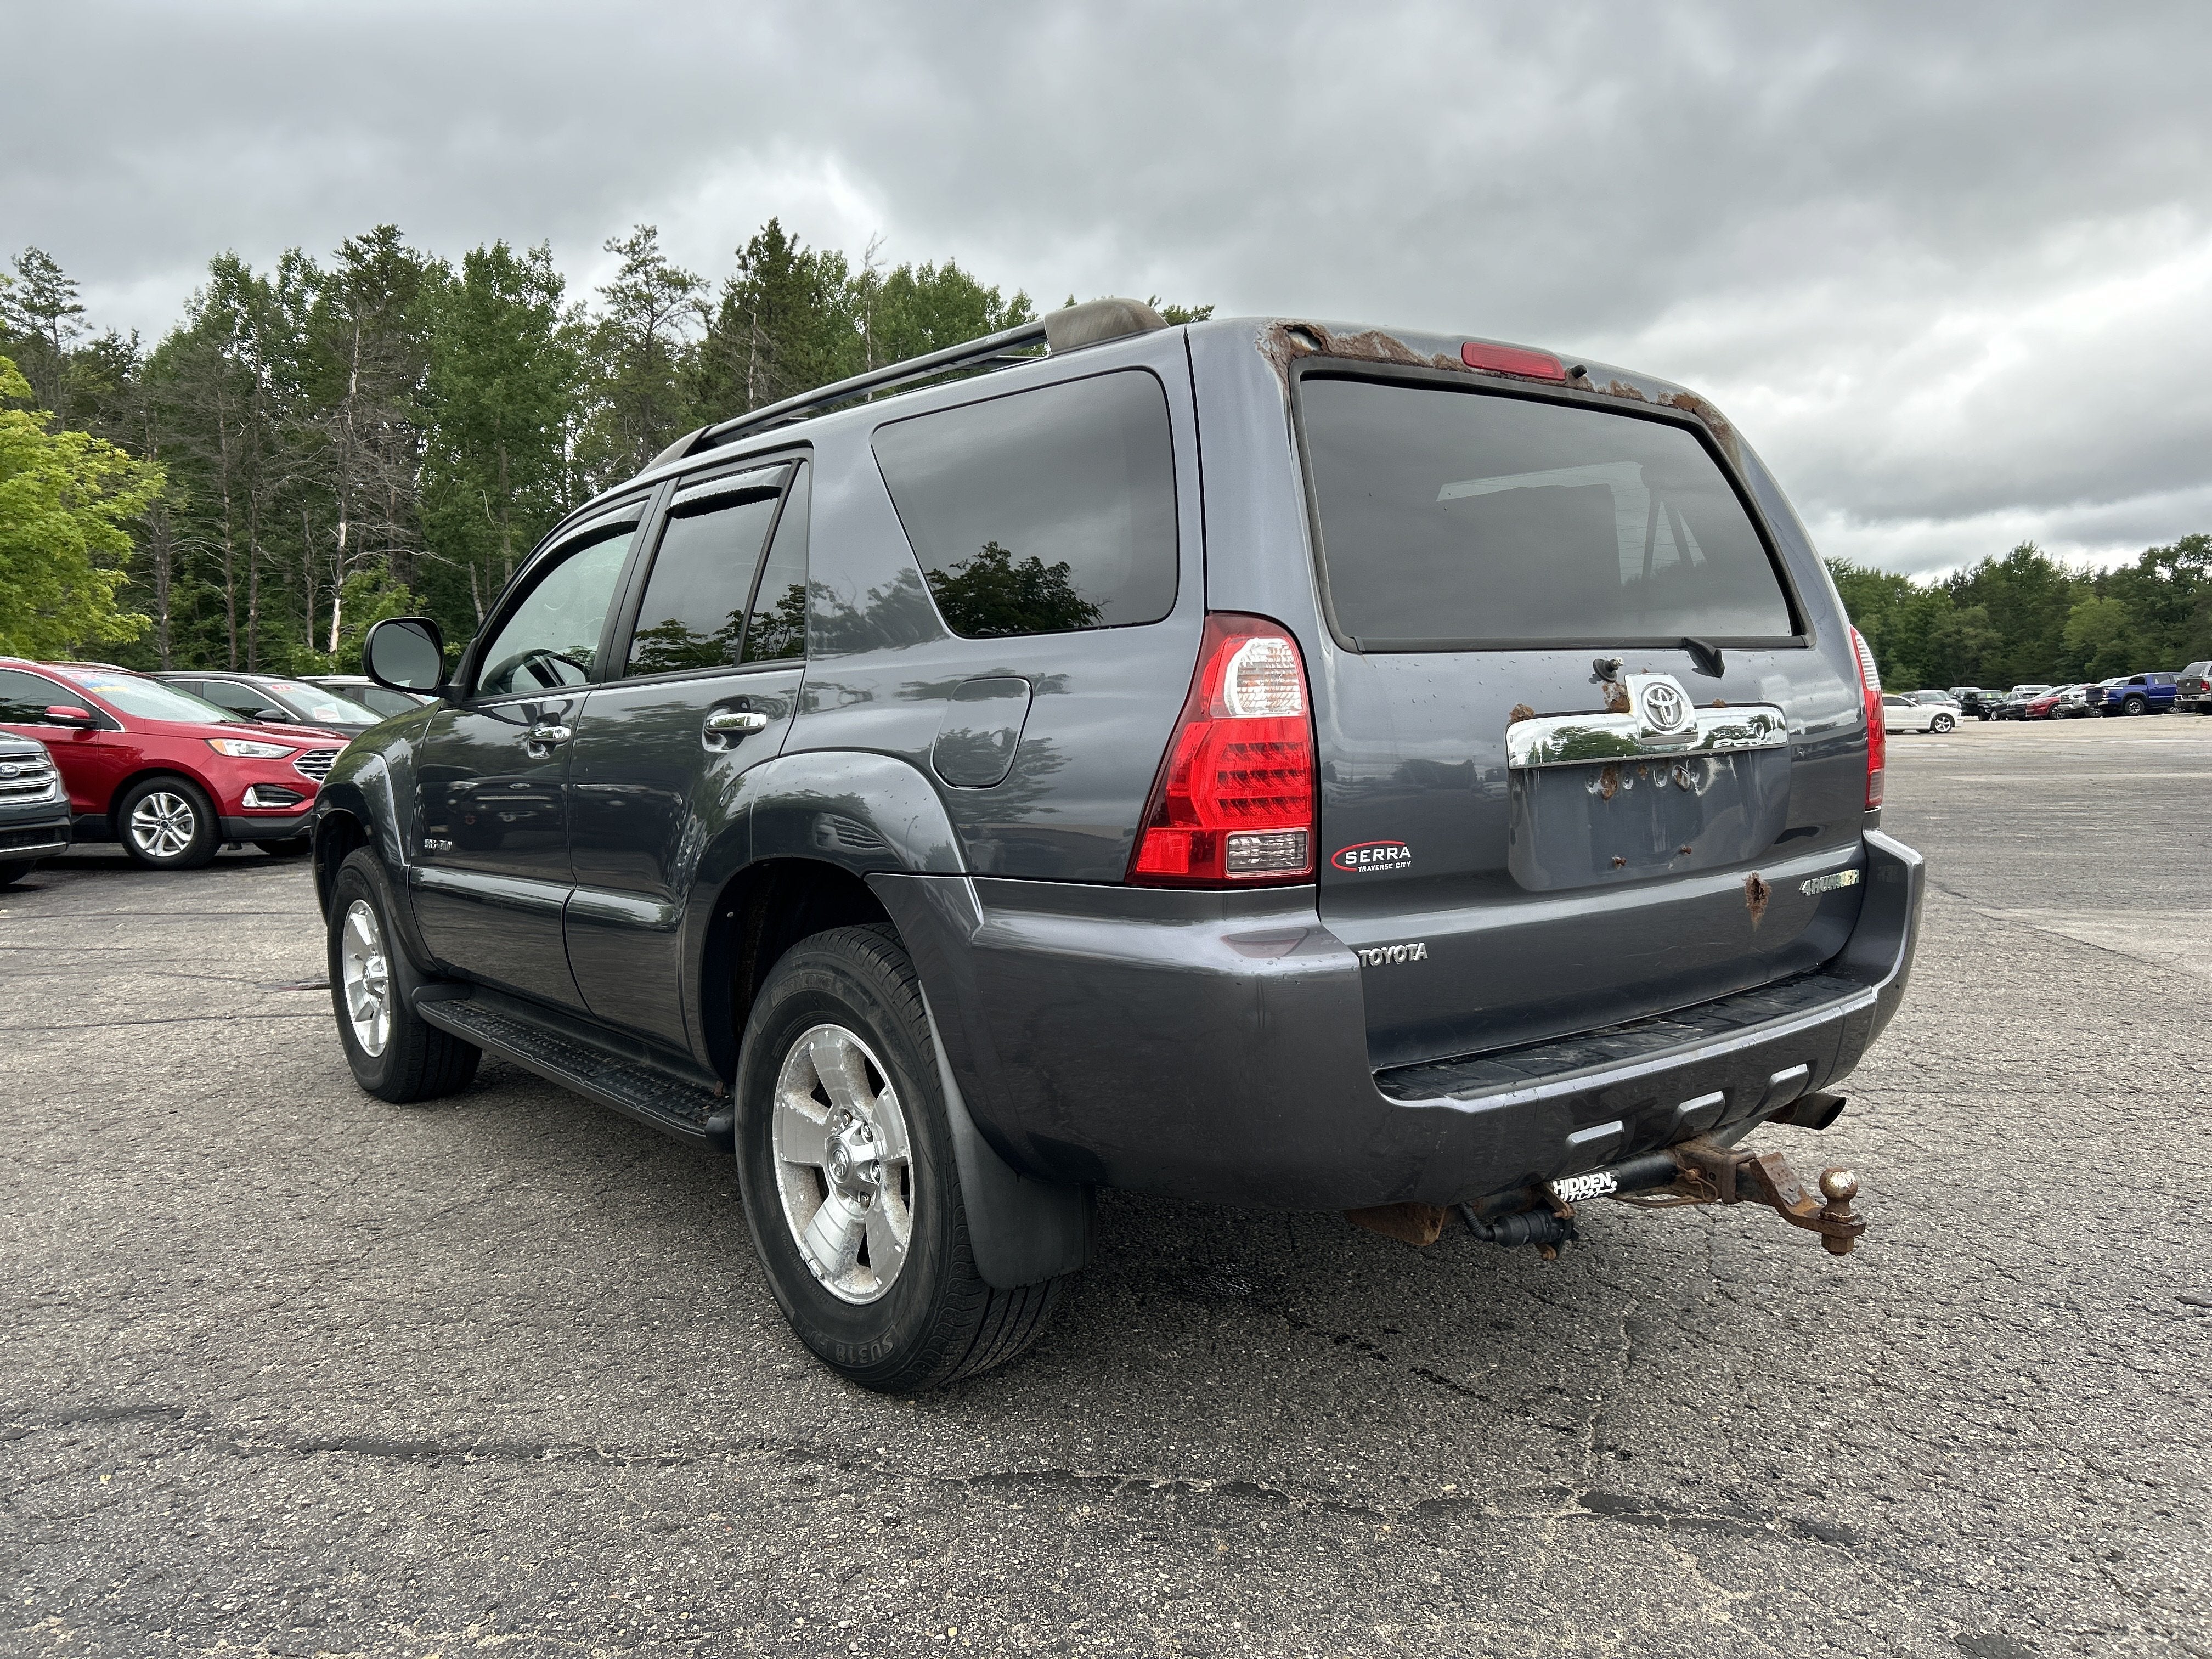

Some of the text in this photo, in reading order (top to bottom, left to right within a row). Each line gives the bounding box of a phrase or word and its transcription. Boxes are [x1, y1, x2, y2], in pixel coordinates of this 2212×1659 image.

[1345, 846, 1411, 864] SERRA
[1358, 861, 1412, 872] TRAVERSE CITY
[1358, 943, 1428, 967] TOYOTA
[770, 972, 834, 1008] WESTLAKE
[1552, 1172, 1611, 1195] HIDDEN
[836, 1333, 894, 1364] SU318
